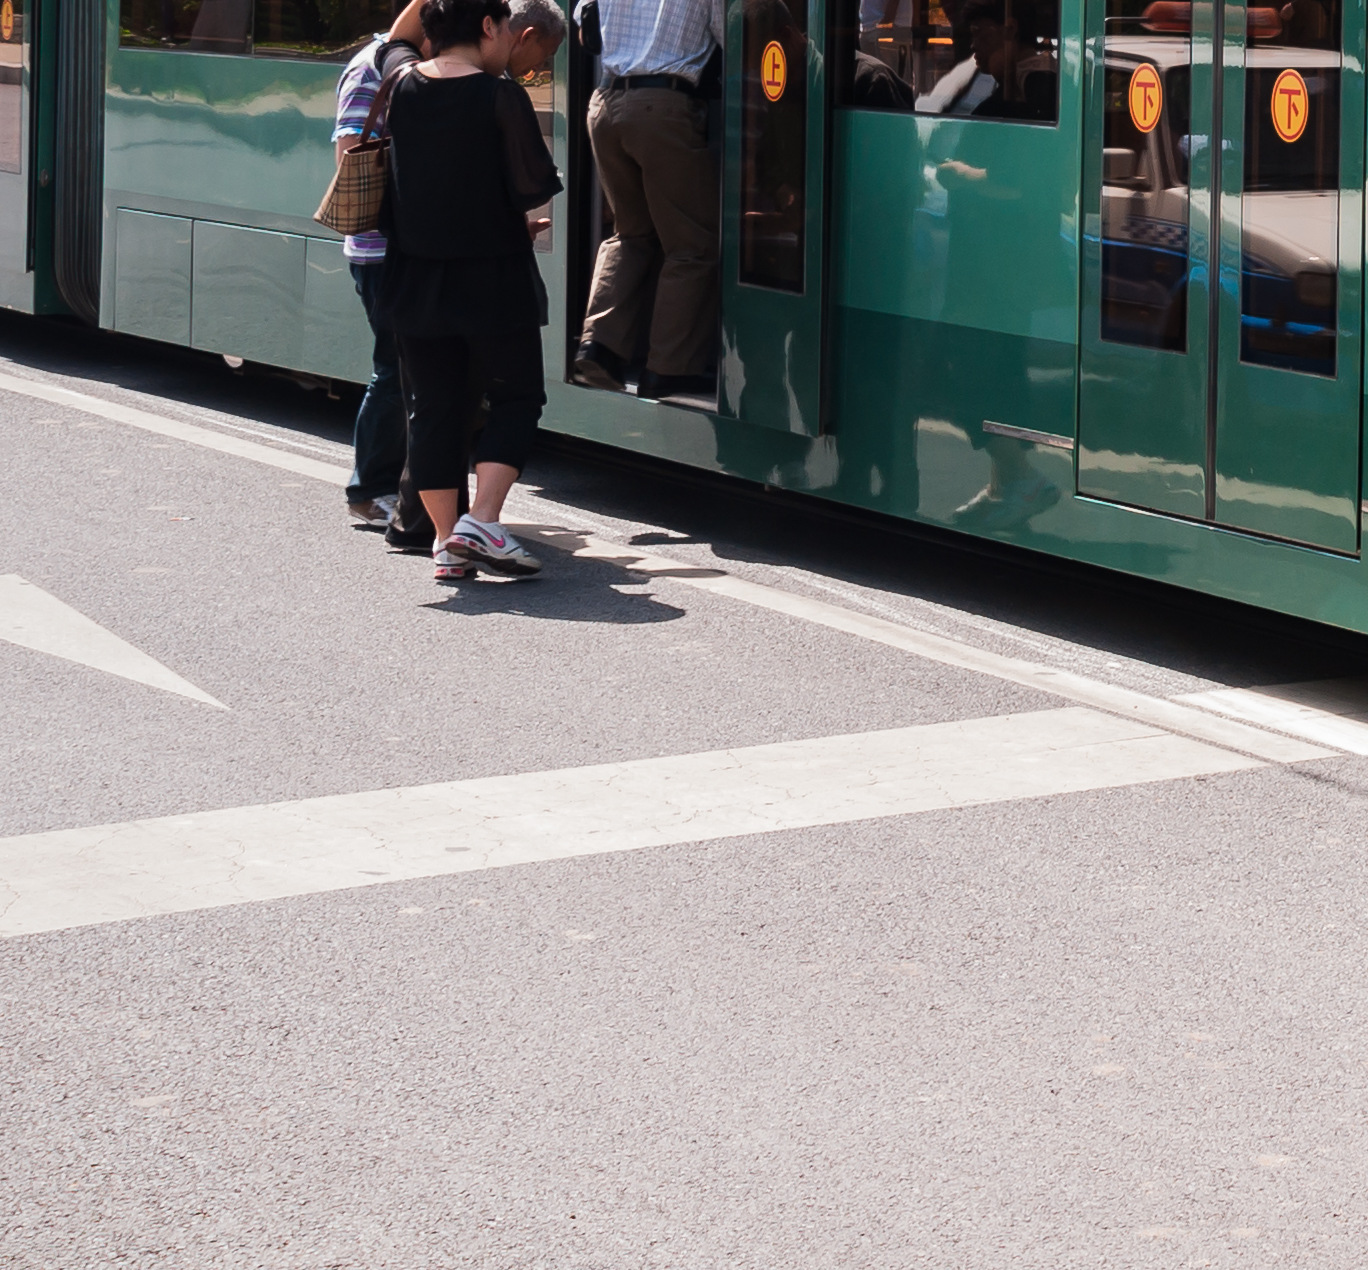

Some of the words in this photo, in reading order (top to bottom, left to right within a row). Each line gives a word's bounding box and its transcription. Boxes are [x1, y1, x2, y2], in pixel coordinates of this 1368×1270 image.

[766, 52, 781, 87] 上
[1135, 81, 1156, 121] 下
[1279, 88, 1301, 130] 下
